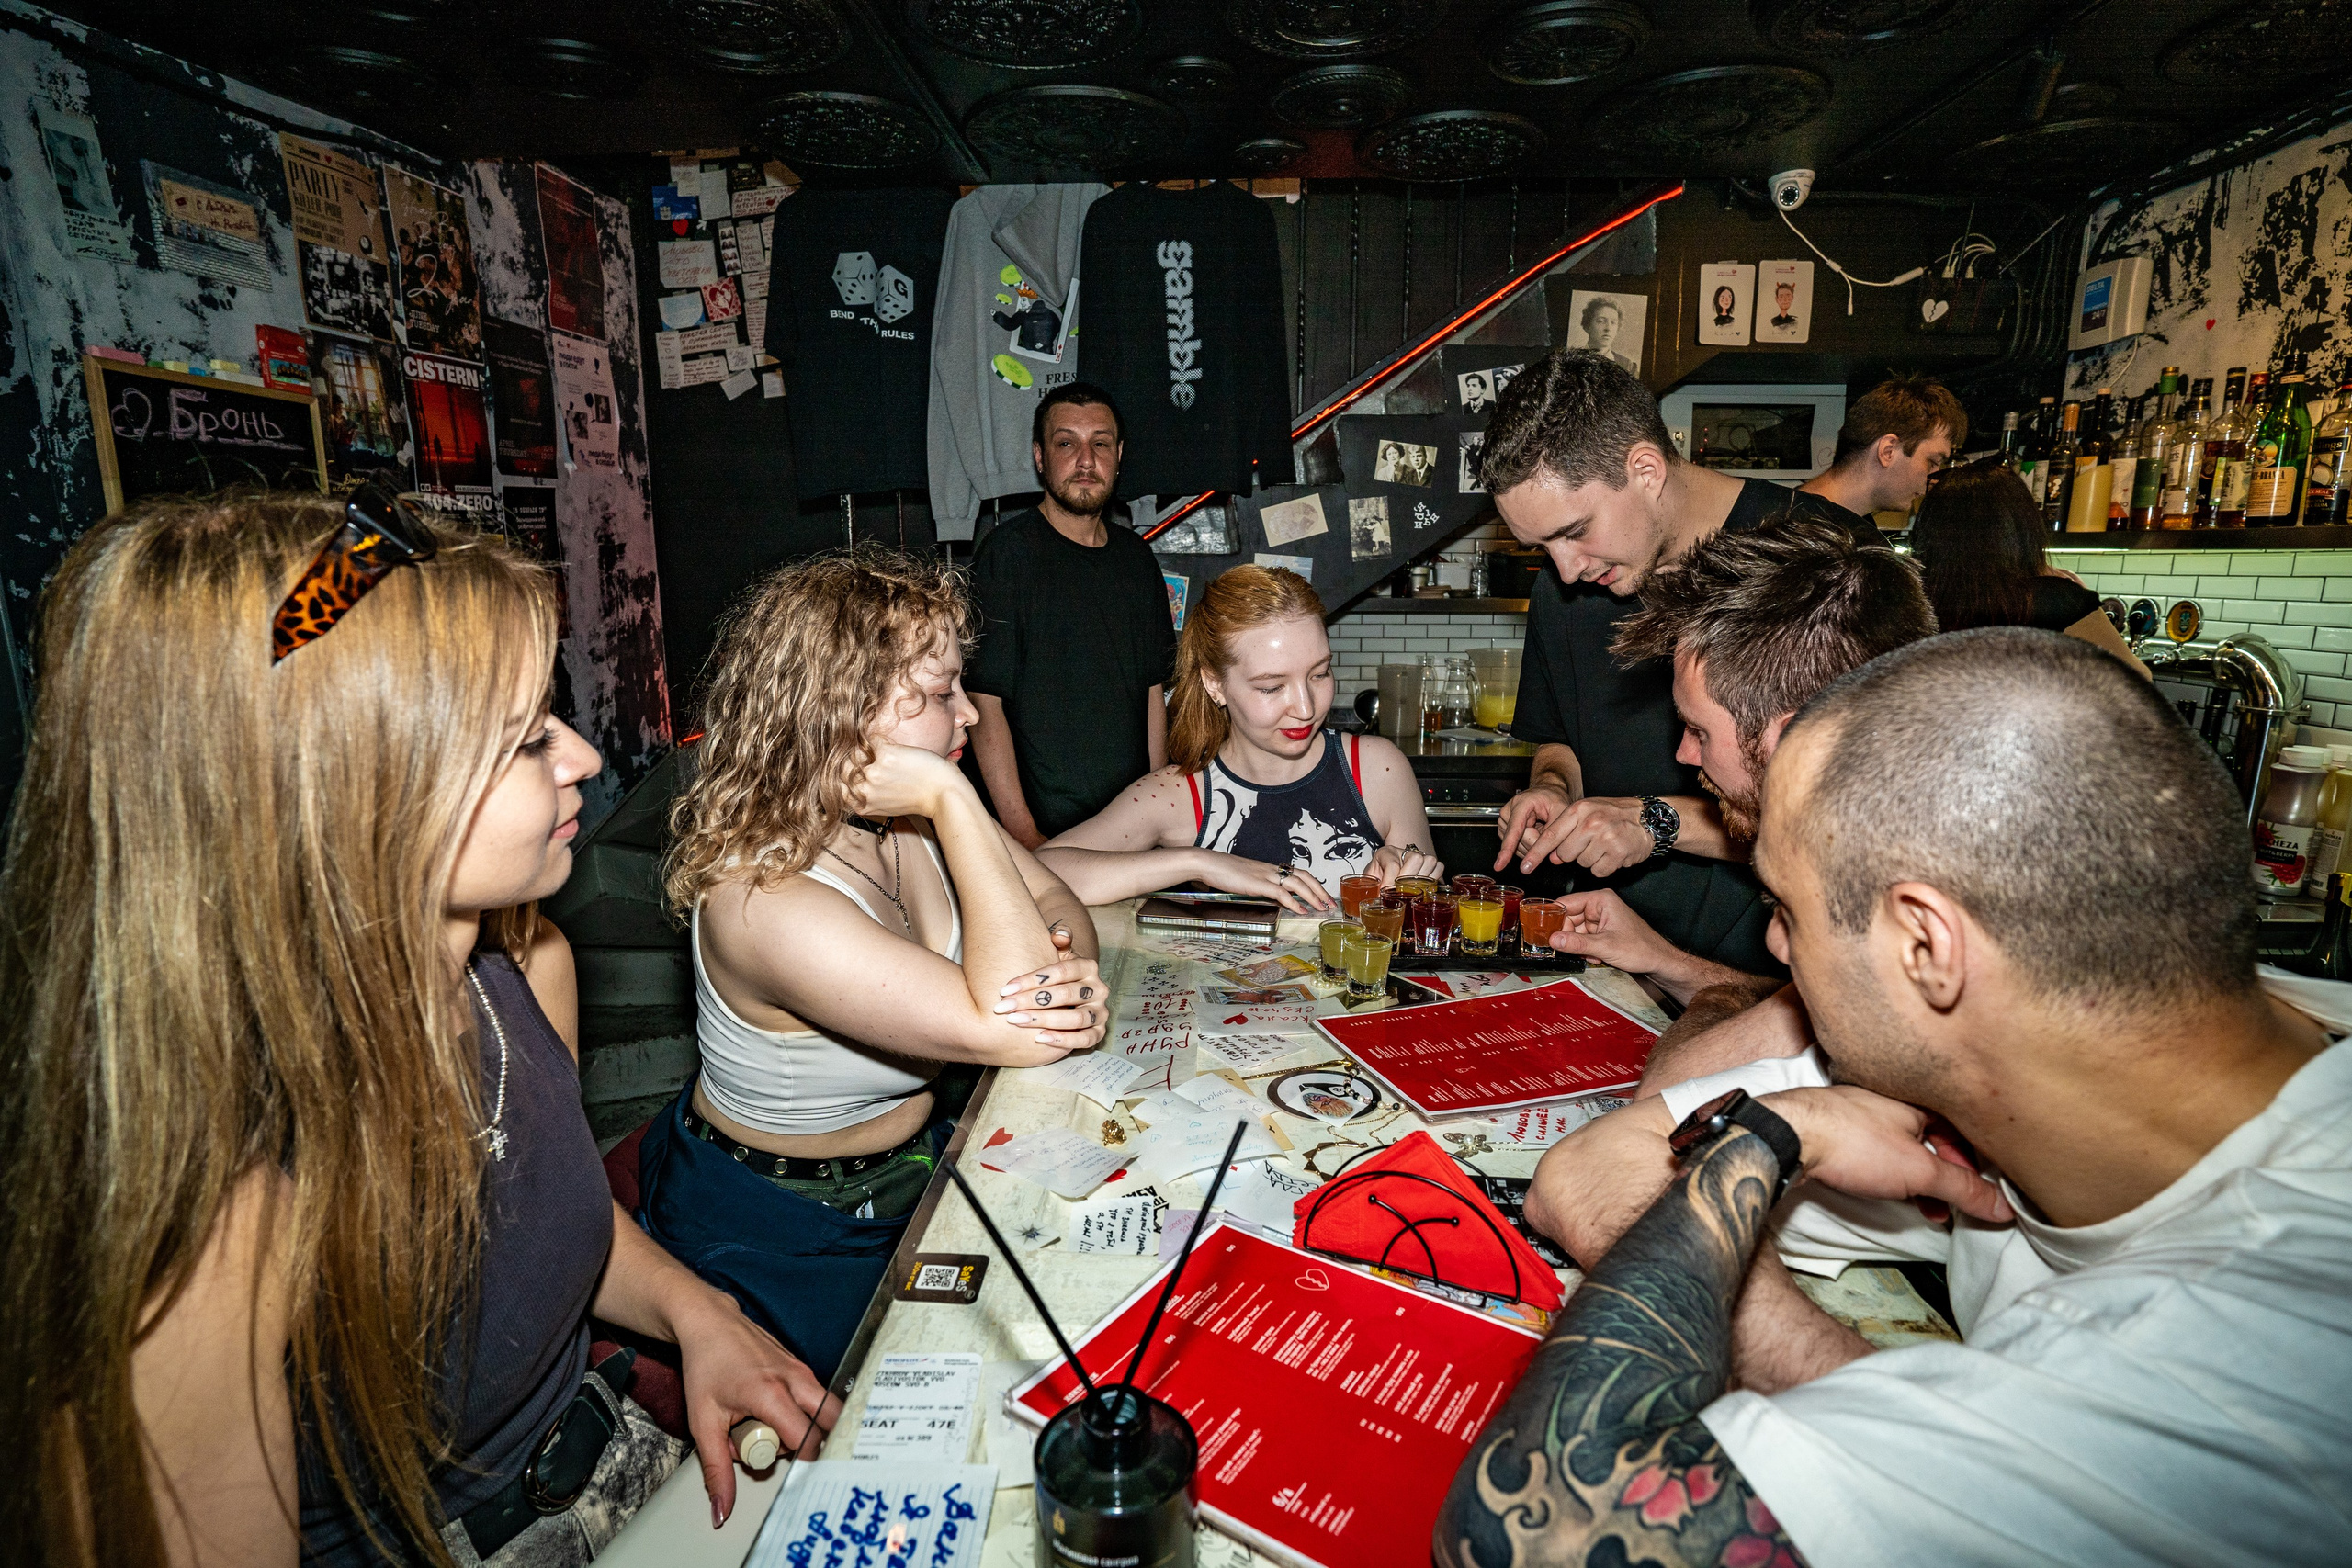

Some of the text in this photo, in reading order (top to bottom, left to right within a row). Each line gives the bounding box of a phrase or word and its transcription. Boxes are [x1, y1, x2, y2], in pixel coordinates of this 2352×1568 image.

[829, 310, 855, 320] BEND
[1157, 240, 1203, 411] gamble
[881, 330, 915, 340] RULES
[403, 356, 480, 388] CISTERN
[169, 386, 285, 441] Бронь
[1126, 1032, 1190, 1055] РУНА
[861, 1420, 956, 1430] SEAT 47E
